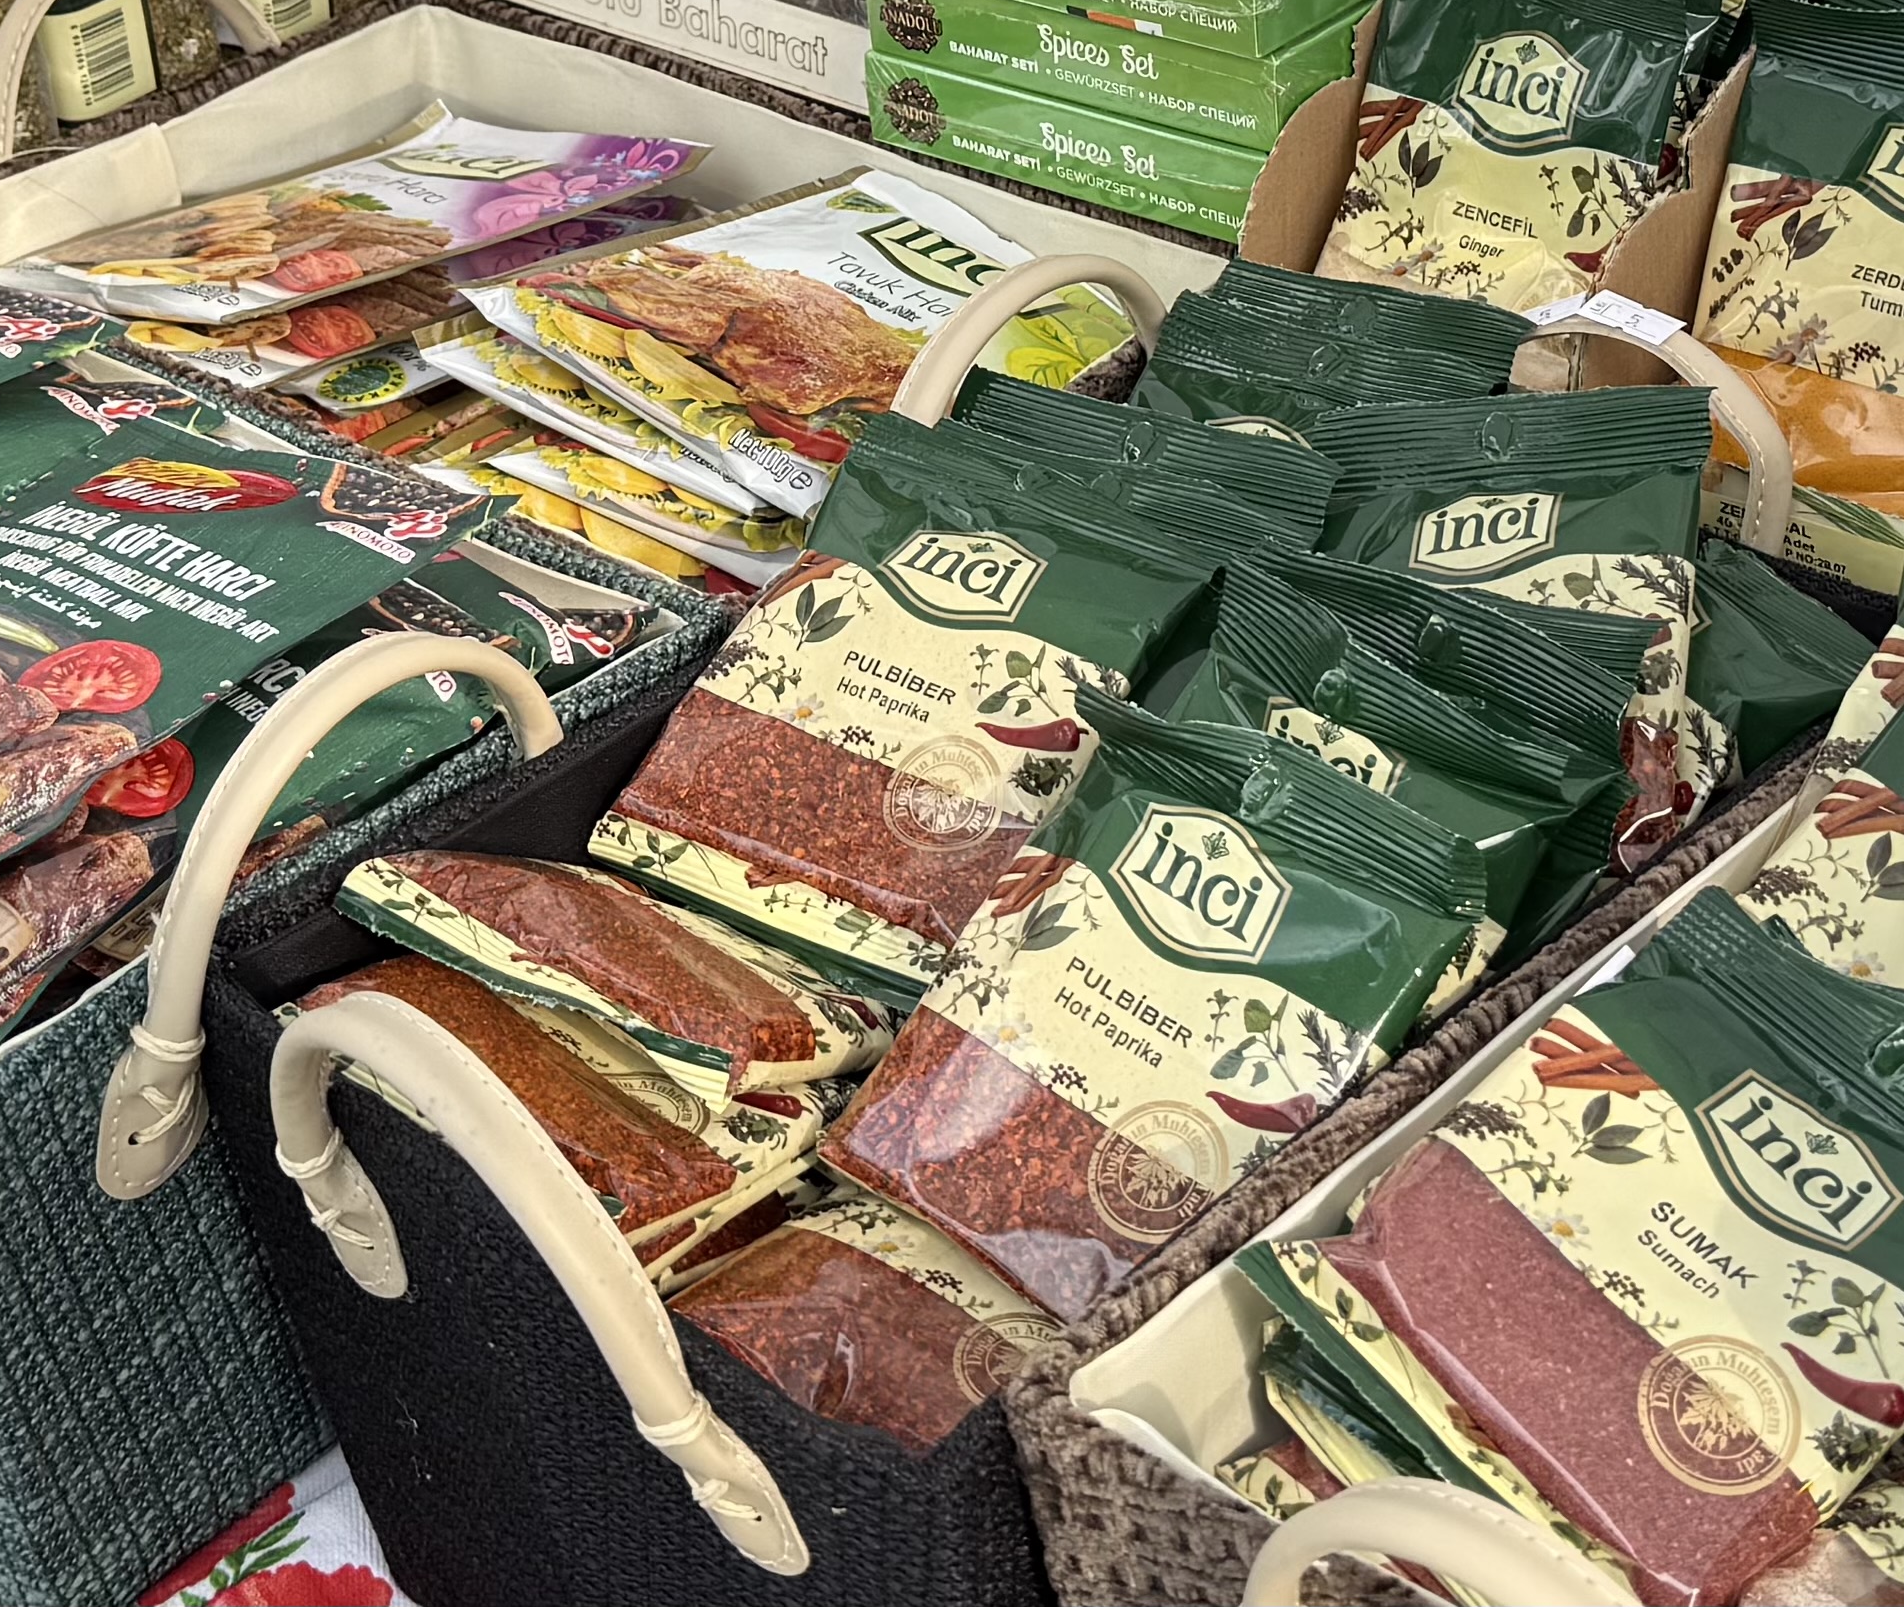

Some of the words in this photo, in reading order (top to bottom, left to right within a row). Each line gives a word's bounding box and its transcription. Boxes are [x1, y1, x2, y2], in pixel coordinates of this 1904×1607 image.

[880, 6, 944, 36] ANADOLU
[949, 41, 1009, 66] BAHARAT
[1054, 68, 1136, 98] GEWÜRZSET
[1037, 23, 1111, 68] Spices
[1119, 44, 1159, 80] Set
[1148, 92, 1195, 113] НАБОР
[1199, 103, 1256, 130] СПЕЦИЙ
[1466, 47, 1567, 122] inci
[1452, 200, 1538, 239] ZENCEFİL
[1459, 235, 1505, 258] Ginger
[828, 251, 898, 296] Tavuk
[1425, 497, 1543, 555] inci
[99, 523, 201, 572] KÖFTE
[176, 552, 275, 602] HARCI
[897, 536, 1023, 605] inci
[837, 676, 867, 699] Hot
[868, 686, 930, 725] Paprika
[843, 650, 957, 705] PULBİBER
[1137, 822, 1264, 943] inci
[1055, 986, 1090, 1021] Hot
[1092, 1014, 1163, 1068] Paprika
[1066, 956, 1193, 1048] PULBİBER
[1720, 1095, 1874, 1233] inci
[1638, 1228, 1720, 1300] Sumach
[1650, 1201, 1760, 1290] SUMAK
